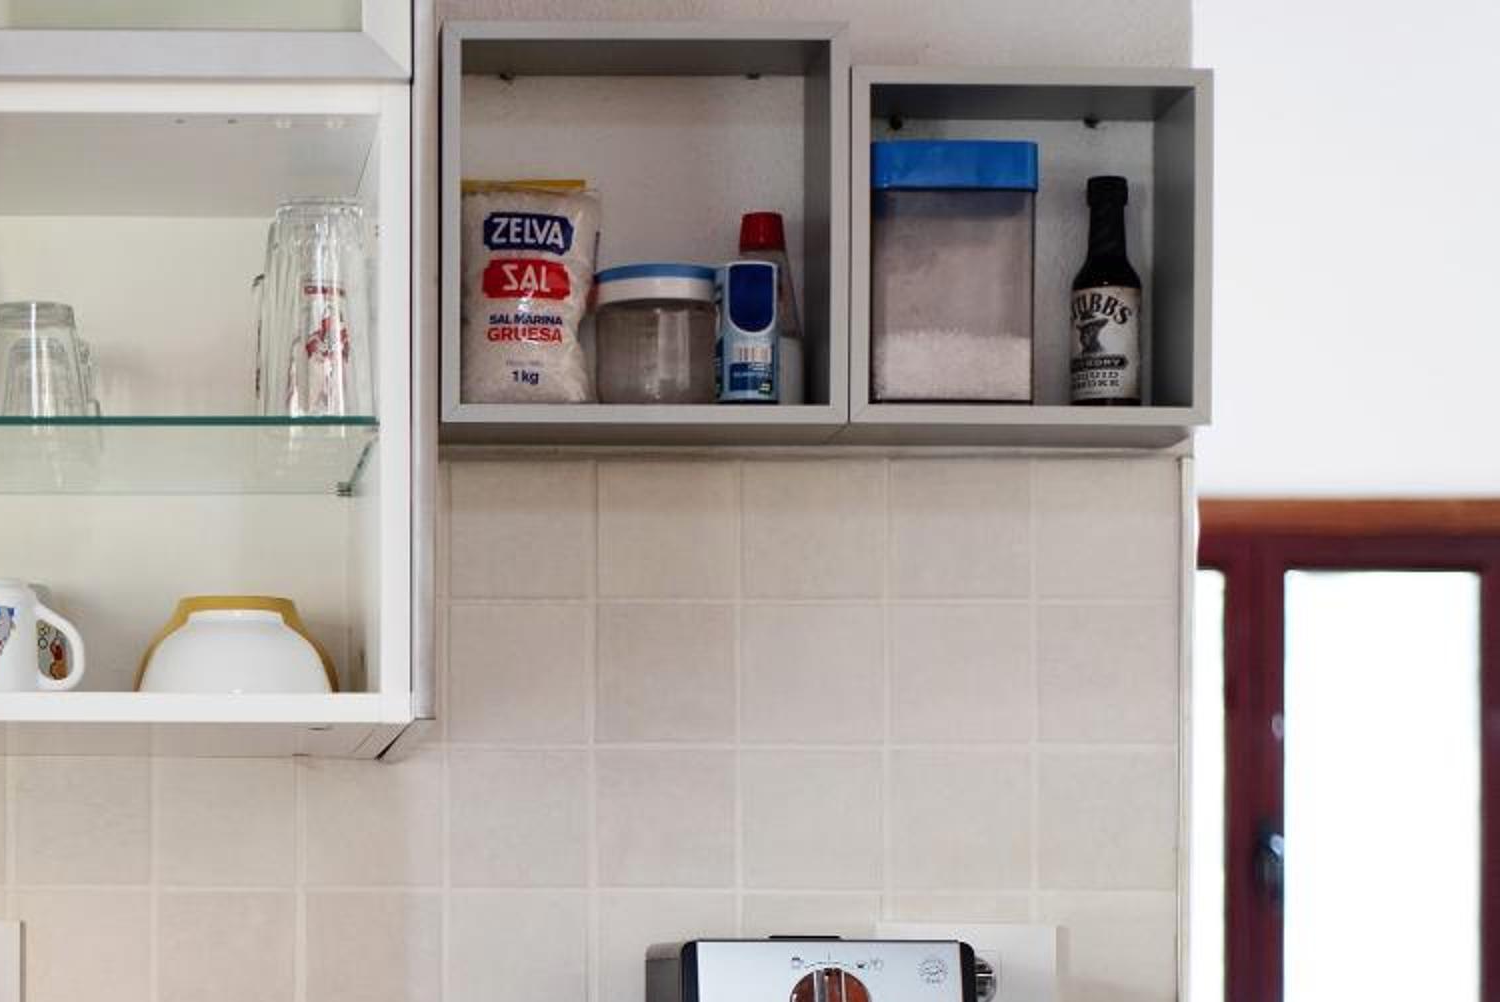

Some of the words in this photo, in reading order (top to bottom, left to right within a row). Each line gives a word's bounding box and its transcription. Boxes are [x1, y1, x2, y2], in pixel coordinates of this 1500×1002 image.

[491, 217, 565, 249] ZELVA
[502, 263, 551, 293] SAL
[489, 312, 511, 325] SAL
[513, 312, 563, 326] MARINA
[487, 326, 564, 343] GRUESA
